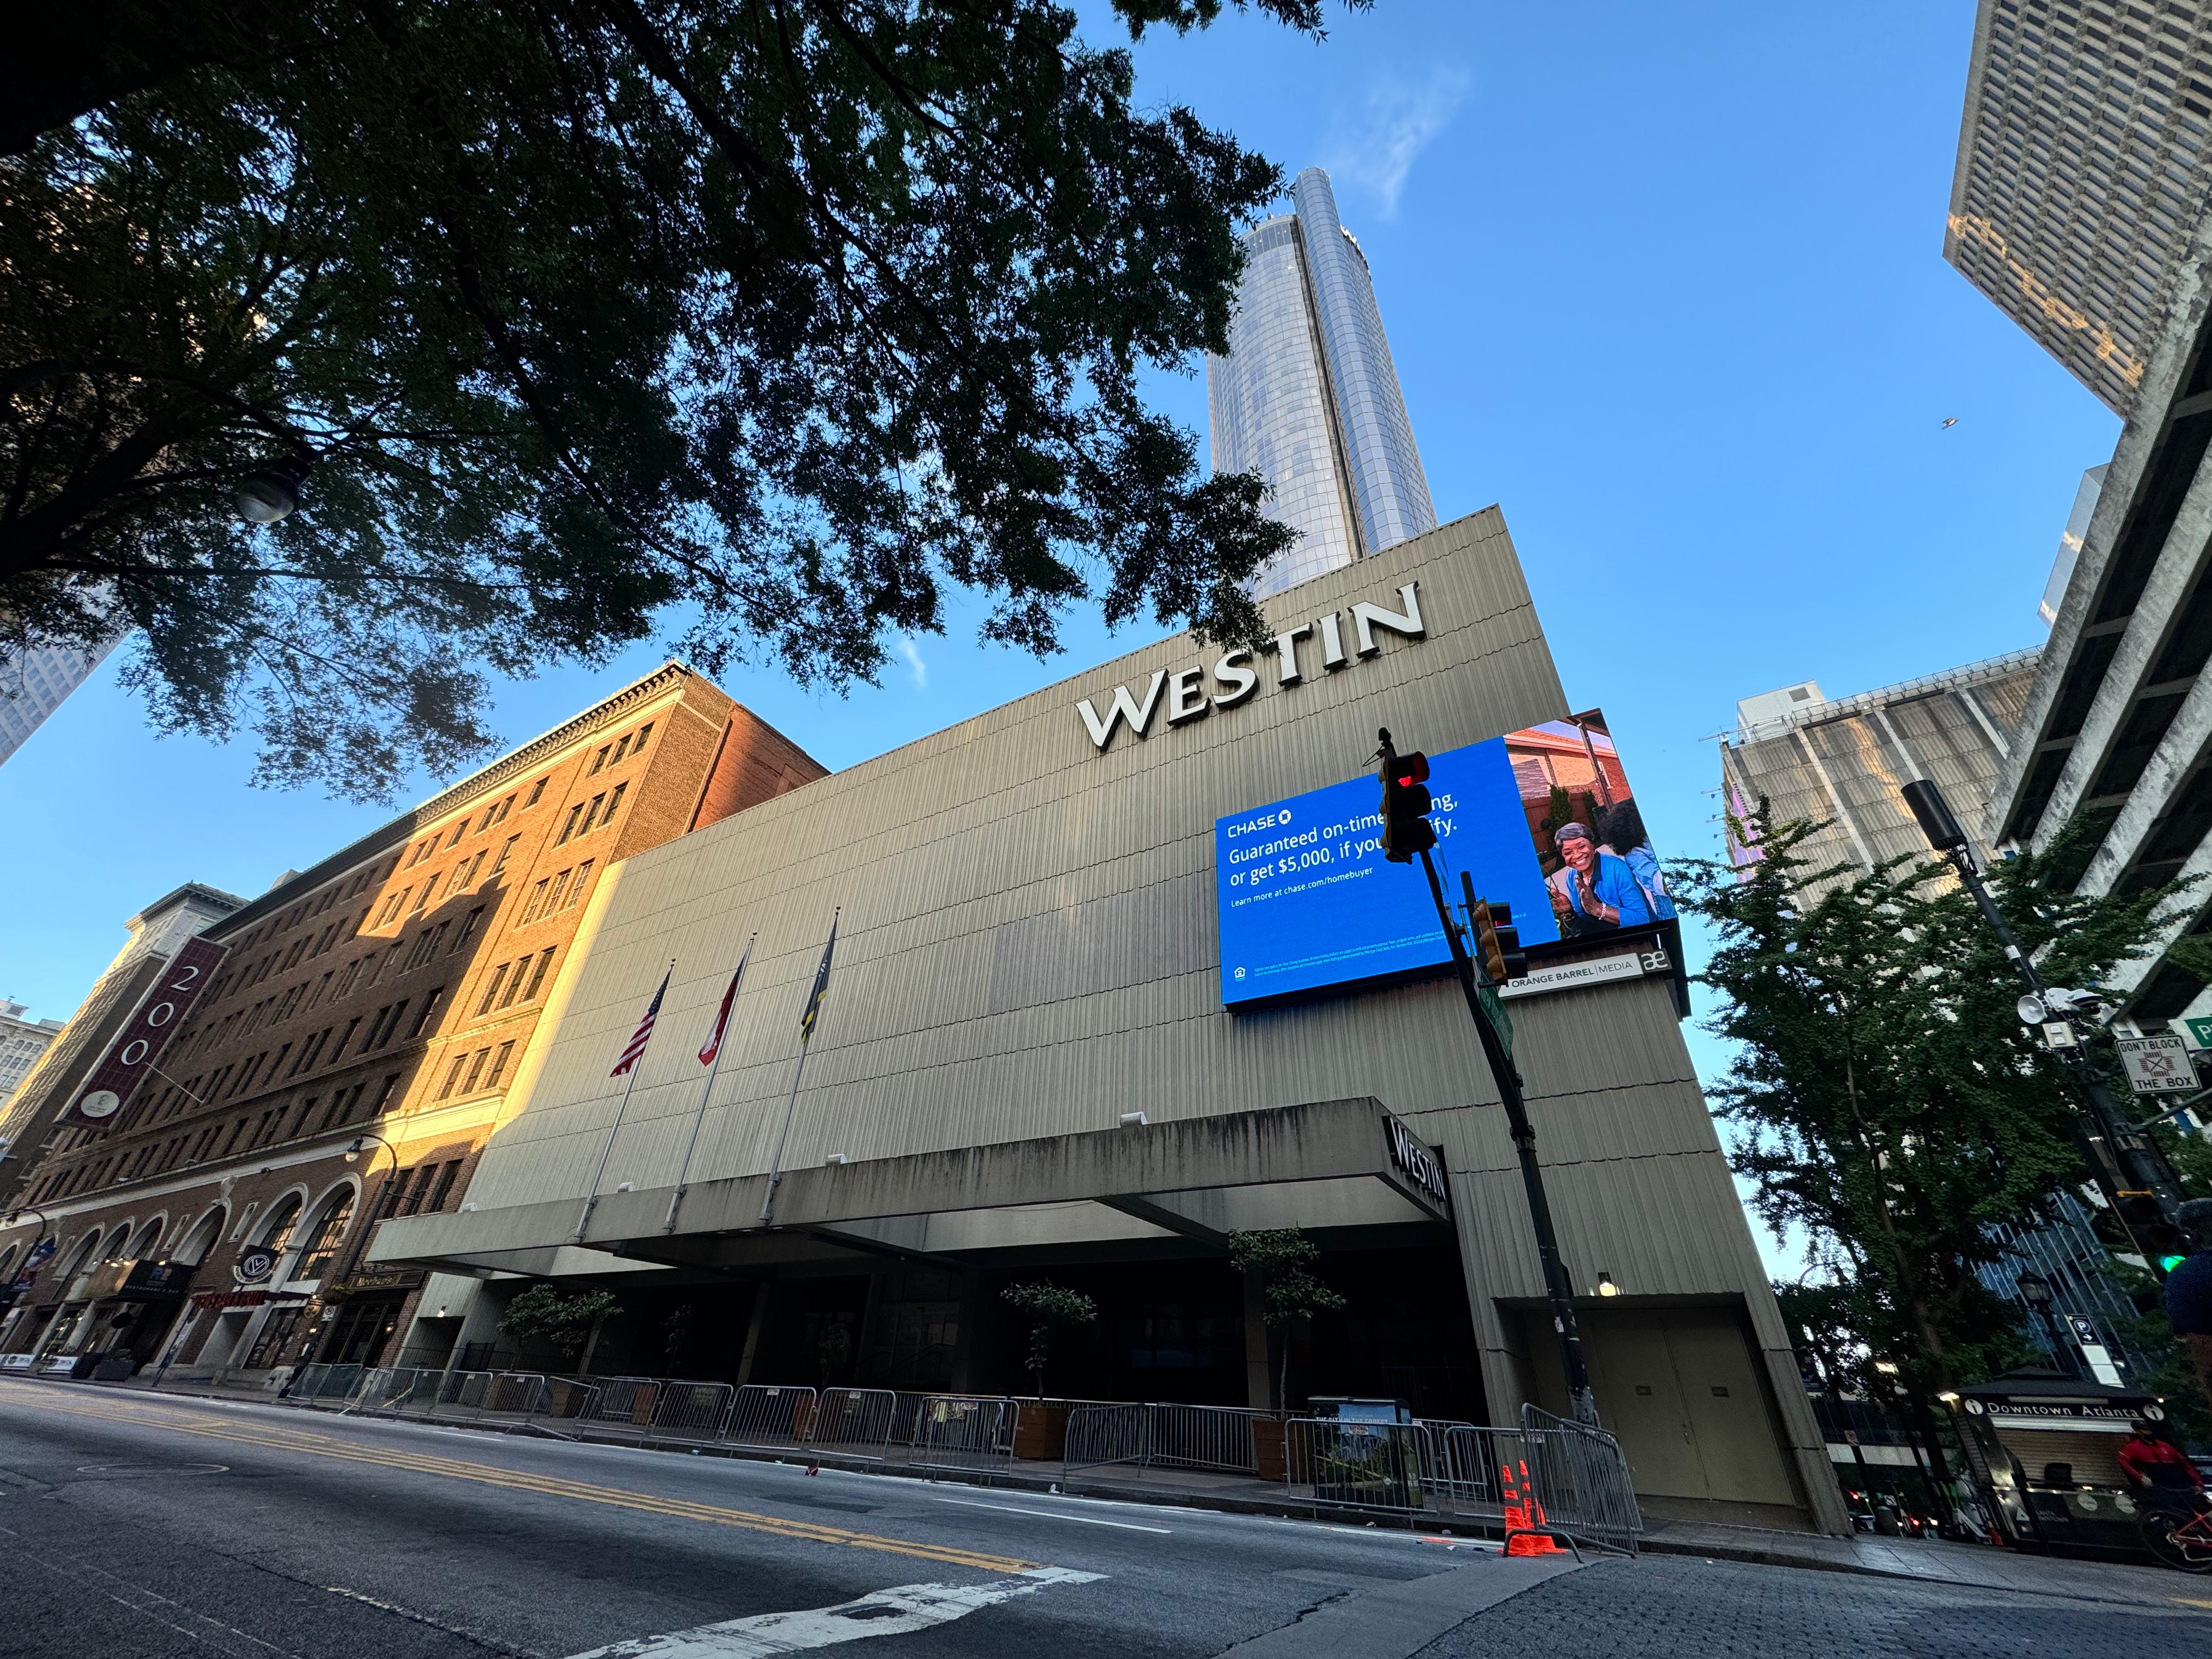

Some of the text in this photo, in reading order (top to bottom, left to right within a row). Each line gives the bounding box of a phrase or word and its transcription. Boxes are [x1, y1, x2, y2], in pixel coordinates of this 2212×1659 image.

[1075, 580, 1426, 751] WESTIN
[1228, 814, 1277, 838] CHASE
[1229, 826, 1318, 864] Guaranteed
[1230, 871, 1246, 886] or
[1250, 863, 1275, 885] get
[1278, 847, 1335, 874] $5,000,
[1339, 840, 1351, 859] if
[1231, 867, 1373, 908] Learn more at chase.com/homebuyer
[1511, 961, 1633, 989] ORANGE BARREL MEDIA
[2148, 1039, 2181, 1049] BLOCK
[2196, 1025, 2212, 1040] P
[2136, 1076, 2194, 1090] THE BOX
[1390, 1116, 1447, 1201] WESTIN
[1987, 1402, 2140, 1418] Downtown Atlanta
